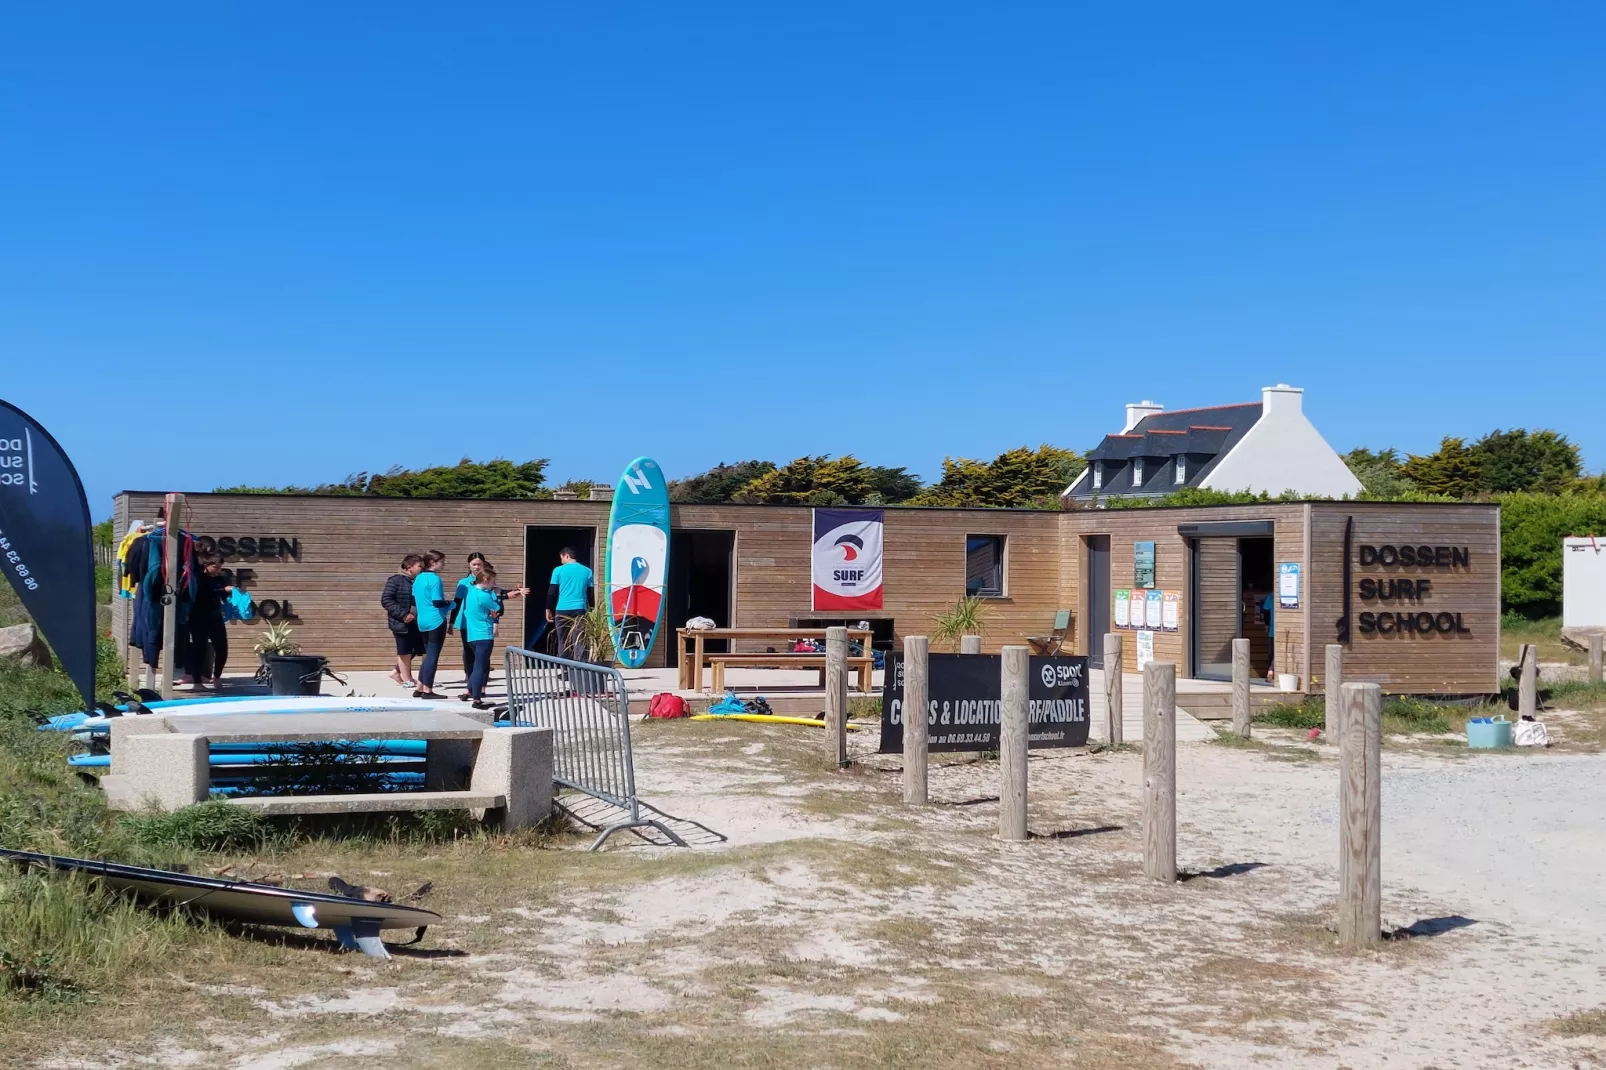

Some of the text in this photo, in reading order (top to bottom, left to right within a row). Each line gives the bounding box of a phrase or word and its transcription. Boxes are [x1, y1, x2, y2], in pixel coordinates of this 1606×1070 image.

[195, 536, 298, 558] OSSEN
[1359, 545, 1469, 567] DOSSEN
[833, 569, 864, 581] SURF
[1359, 578, 1431, 600] SURF
[1359, 611, 1471, 634] SCHOOL
[940, 700, 951, 725] &
[954, 699, 1001, 725] LOCATIO
[1028, 698, 1085, 724] RF/PADDLE
